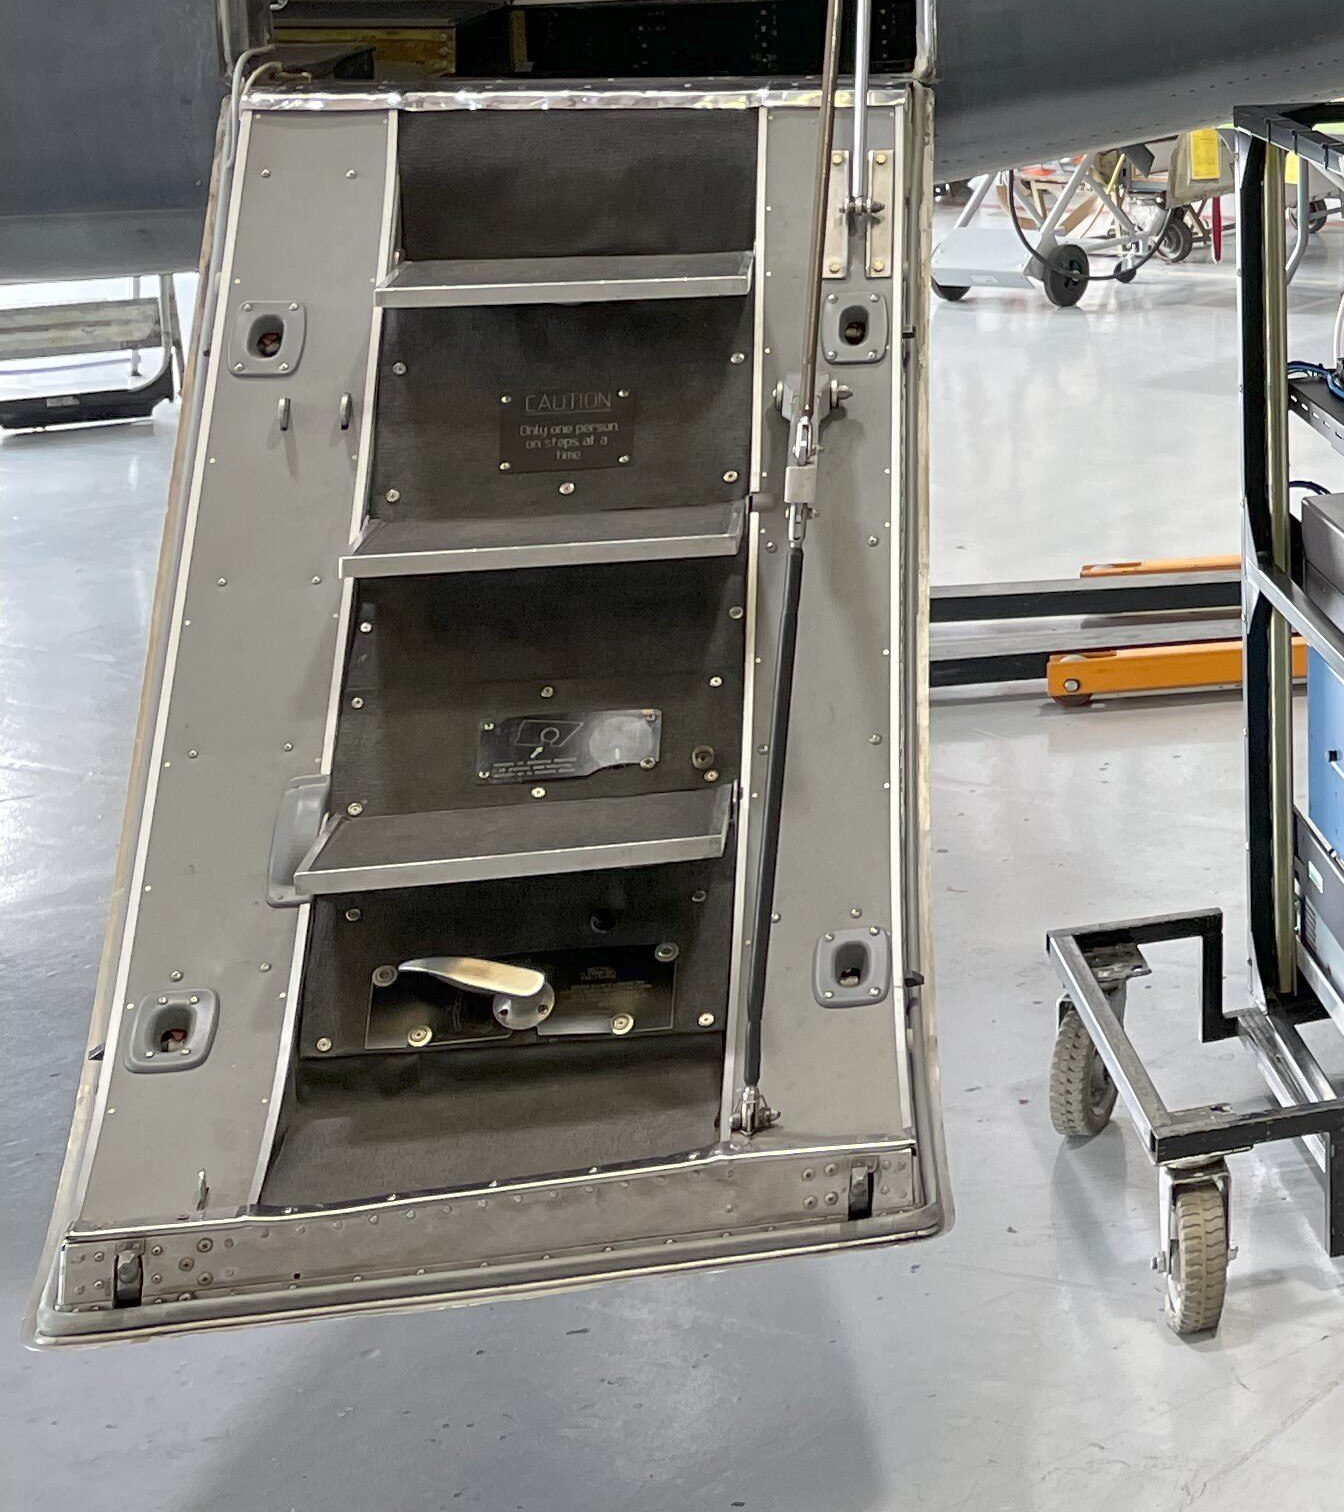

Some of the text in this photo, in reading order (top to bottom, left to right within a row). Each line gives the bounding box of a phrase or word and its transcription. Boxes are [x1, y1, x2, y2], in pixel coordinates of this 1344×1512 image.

[525, 392, 612, 411] CAUTION
[520, 422, 619, 438] Only one person
[525, 434, 608, 449] on steps at a
[556, 450, 582, 461] time
